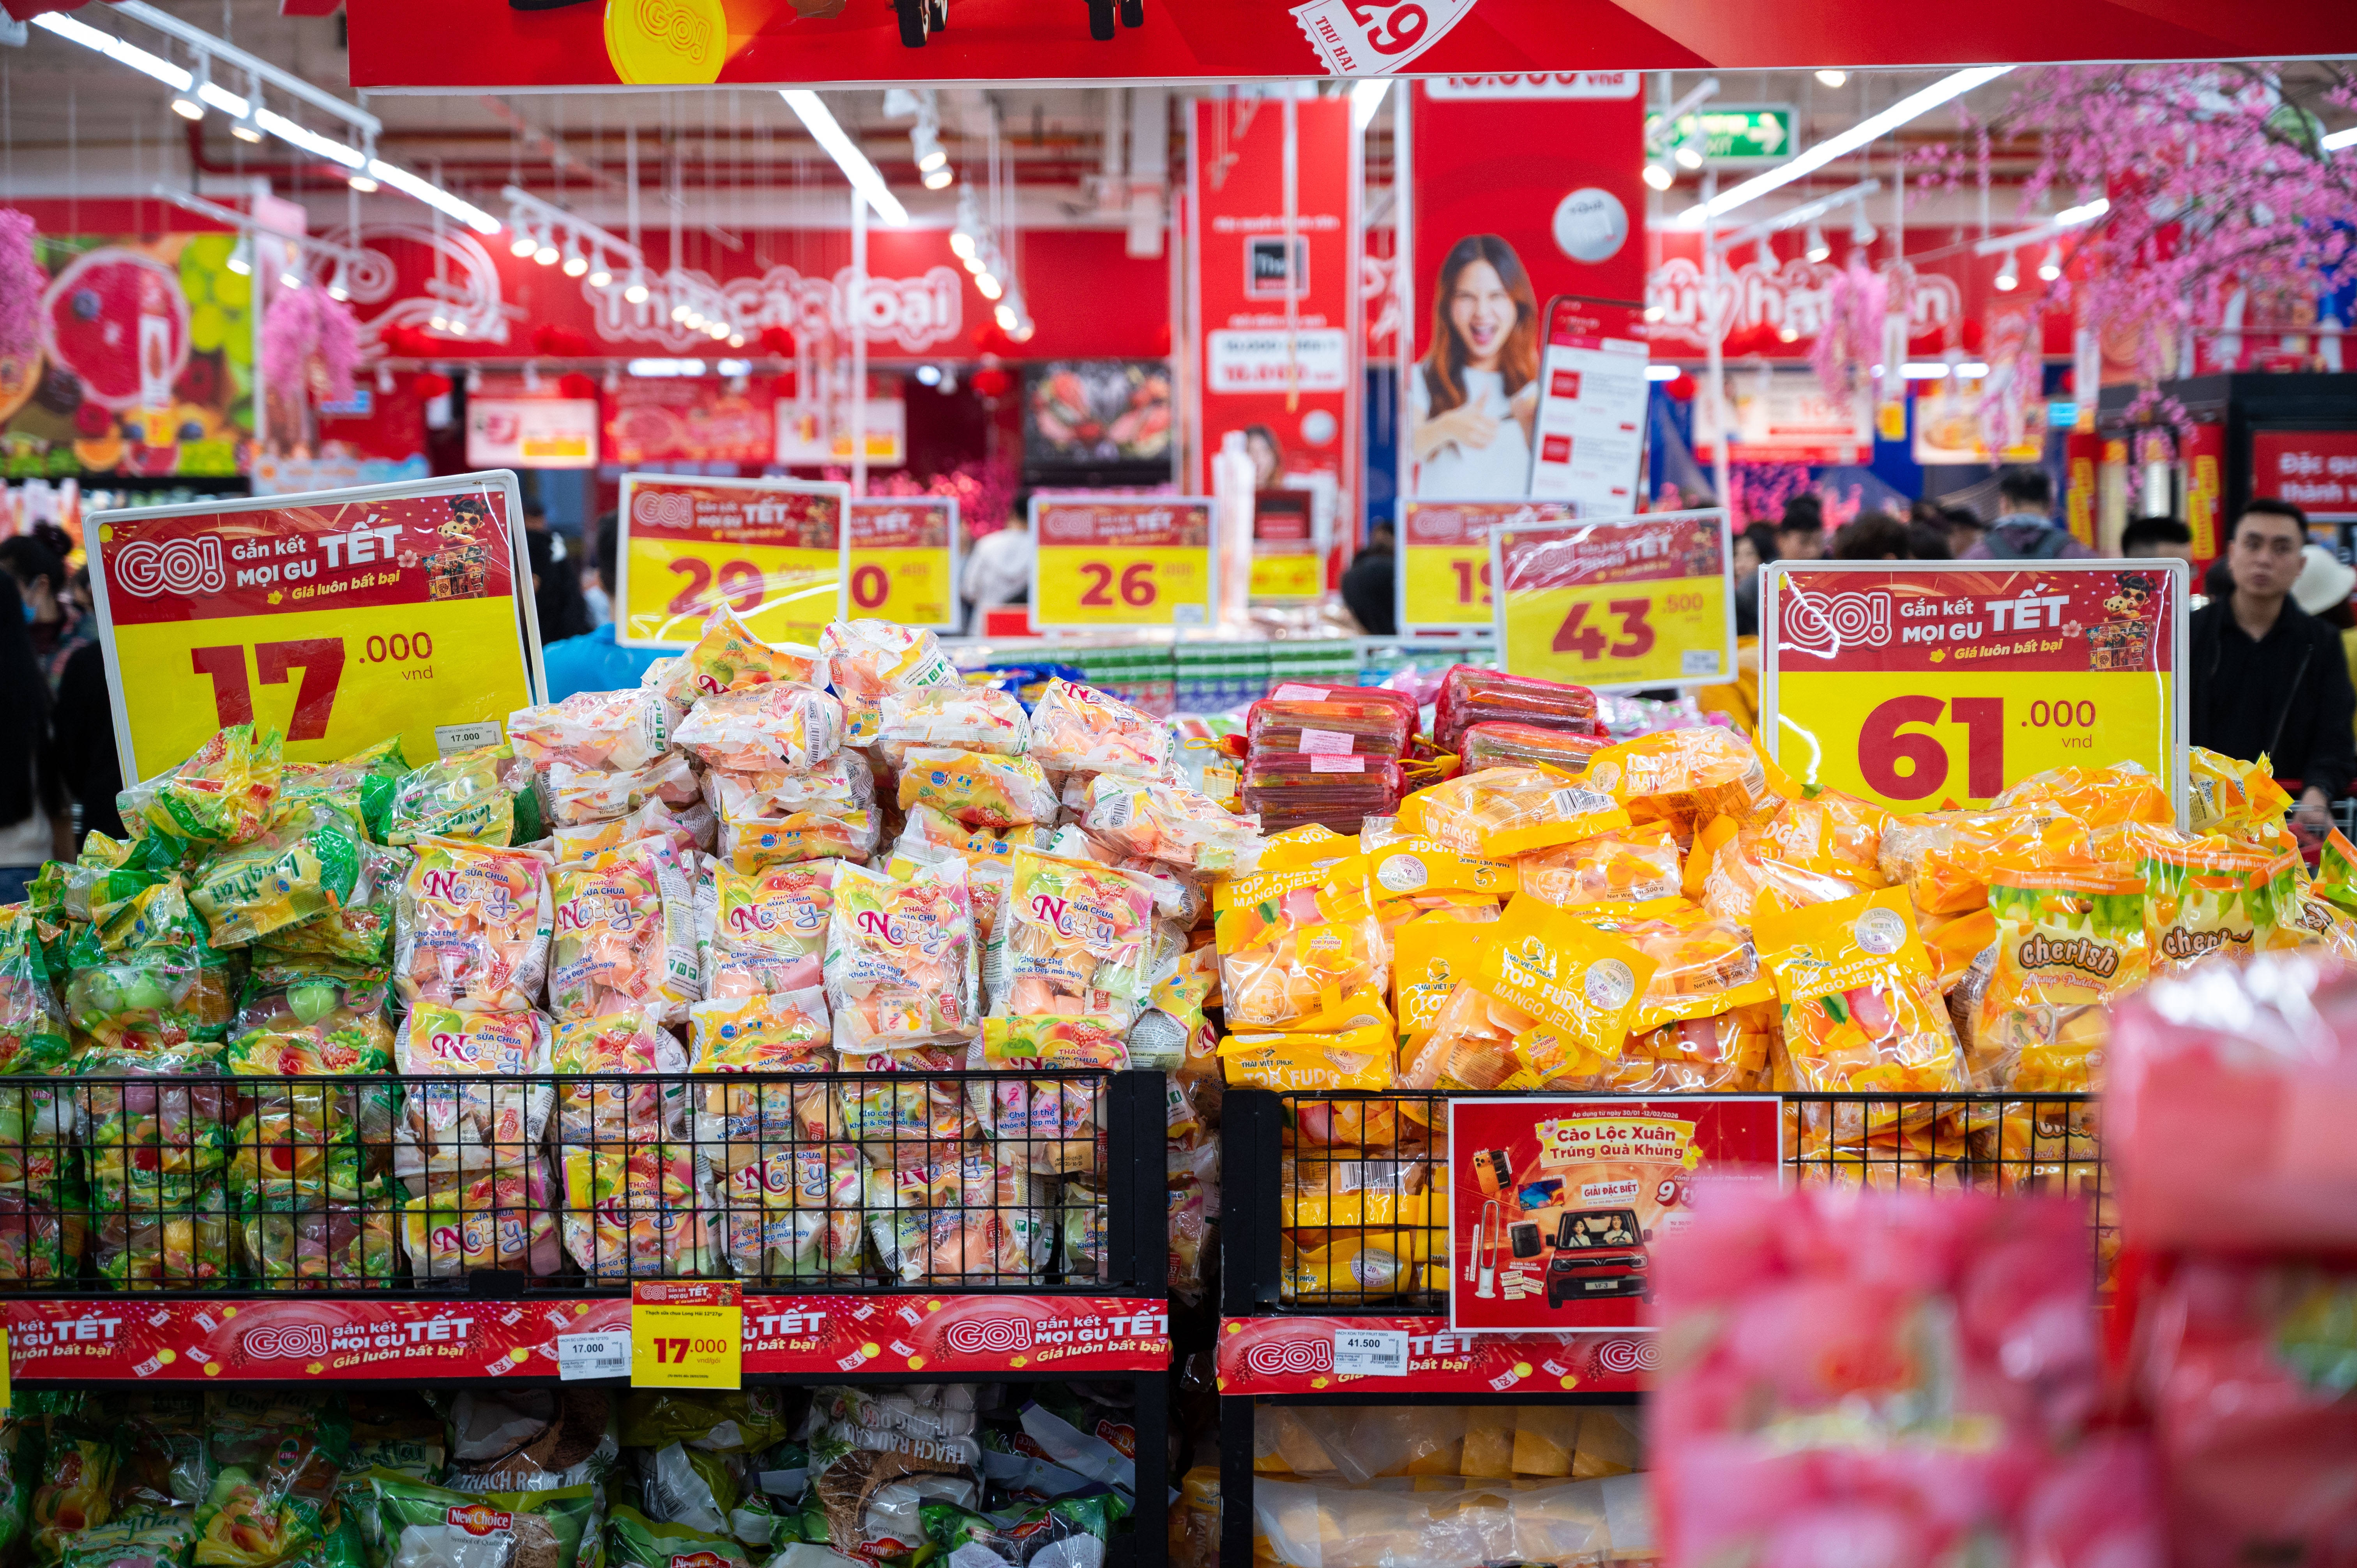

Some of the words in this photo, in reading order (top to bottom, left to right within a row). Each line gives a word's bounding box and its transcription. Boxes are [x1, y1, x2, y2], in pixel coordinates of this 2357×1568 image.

[1315, 15, 1343, 43] THỨ
[1332, 45, 1357, 72] HAI
[634, 491, 694, 529] GO!
[232, 538, 270, 561] Gắn
[275, 534, 306, 555] kết
[318, 514, 403, 570] TẾT
[115, 536, 226, 597] GO!
[236, 563, 283, 590] MỌI
[284, 559, 317, 582] GU
[292, 584, 315, 600] Giá
[316, 579, 350, 597] luôn
[351, 572, 377, 590] bất
[378, 569, 400, 588] bại
[666, 556, 764, 617] 29
[1079, 562, 1157, 607] 26
[1785, 588, 1892, 647] GO!
[1901, 598, 1938, 618] Gắn
[1942, 598, 1974, 617] kết
[1985, 583, 2070, 633] TẾT
[1551, 598, 1656, 662] 43
[1903, 625, 1945, 644] MỌI
[1949, 622, 1983, 640] GU
[1954, 645, 1977, 660] Giá
[1979, 642, 2012, 657] luôn
[2014, 638, 2039, 655] bất
[2041, 638, 2063, 655] bại
[401, 665, 433, 681] vnd
[192, 637, 346, 744] 17
[451, 733, 479, 742] 17.000
[1858, 694, 2004, 800] 61
[2062, 734, 2092, 749] vnd
[1425, 816, 1439, 835] TOP
[1442, 823, 1479, 846] FUDGE
[465, 869, 484, 879] SỮA
[484, 870, 509, 883] CHUA
[1230, 876, 1264, 895] TOP
[583, 888, 599, 897] SỮA
[766, 898, 785, 907] SỮA
[786, 895, 811, 905] CHUA
[1081, 895, 1106, 908] THẠCH
[1233, 883, 1283, 907] MANGO
[1286, 873, 1329, 891] JELLY
[558, 897, 641, 931] Natty
[1032, 894, 1114, 950] Natty
[1073, 902, 1088, 912] SỮA
[1090, 907, 1113, 920] CHUA
[1829, 957, 1888, 978] FUDGE
[2020, 933, 2119, 978] cherish
[2023, 973, 2060, 989] Mango
[2062, 972, 2107, 995] Pudding
[943, 1006, 954, 1014] 432
[1557, 1129, 1591, 1143] Cào
[1596, 1126, 1626, 1140] Lộc
[1631, 1127, 1676, 1141] Xuân
[1550, 1147, 1595, 1160] Trúng
[1600, 1143, 1630, 1157] Quà
[1634, 1144, 1684, 1160] Khủng
[1584, 1185, 1601, 1197] GIẢI
[1603, 1184, 1618, 1195] ĐẶC
[1620, 1183, 1637, 1195] BIỆT
[1657, 1181, 1677, 1202] 9
[641, 1285, 667, 1300] GO!
[688, 1284, 709, 1296] TẾT
[51, 1310, 122, 1342] TẾT
[332, 1321, 366, 1337] gắn
[369, 1321, 398, 1335] kết
[404, 1310, 474, 1342] TẾT
[1036, 1317, 1070, 1331] gắn
[1074, 1315, 1101, 1328] kết
[1108, 1306, 1168, 1338] TẾT
[242, 1324, 327, 1359] GO!
[331, 1336, 370, 1352] MỌI
[375, 1333, 405, 1347] GU
[947, 1317, 1032, 1353] GO!
[1348, 1338, 1380, 1347] 41.500
[11, 1348, 51, 1362] luôn
[53, 1344, 83, 1359] bất
[84, 1344, 111, 1358] bại
[654, 1338, 690, 1363] 17
[1036, 1349, 1064, 1363] Giá
[1067, 1344, 1104, 1357] luôn
[1107, 1339, 1137, 1353] bất
[1140, 1340, 1166, 1354] bại
[1247, 1339, 1333, 1375] GO!
[472, 1511, 509, 1528] Choice
[451, 1535, 473, 1543] Symbol
[481, 1539, 504, 1549] Quality
